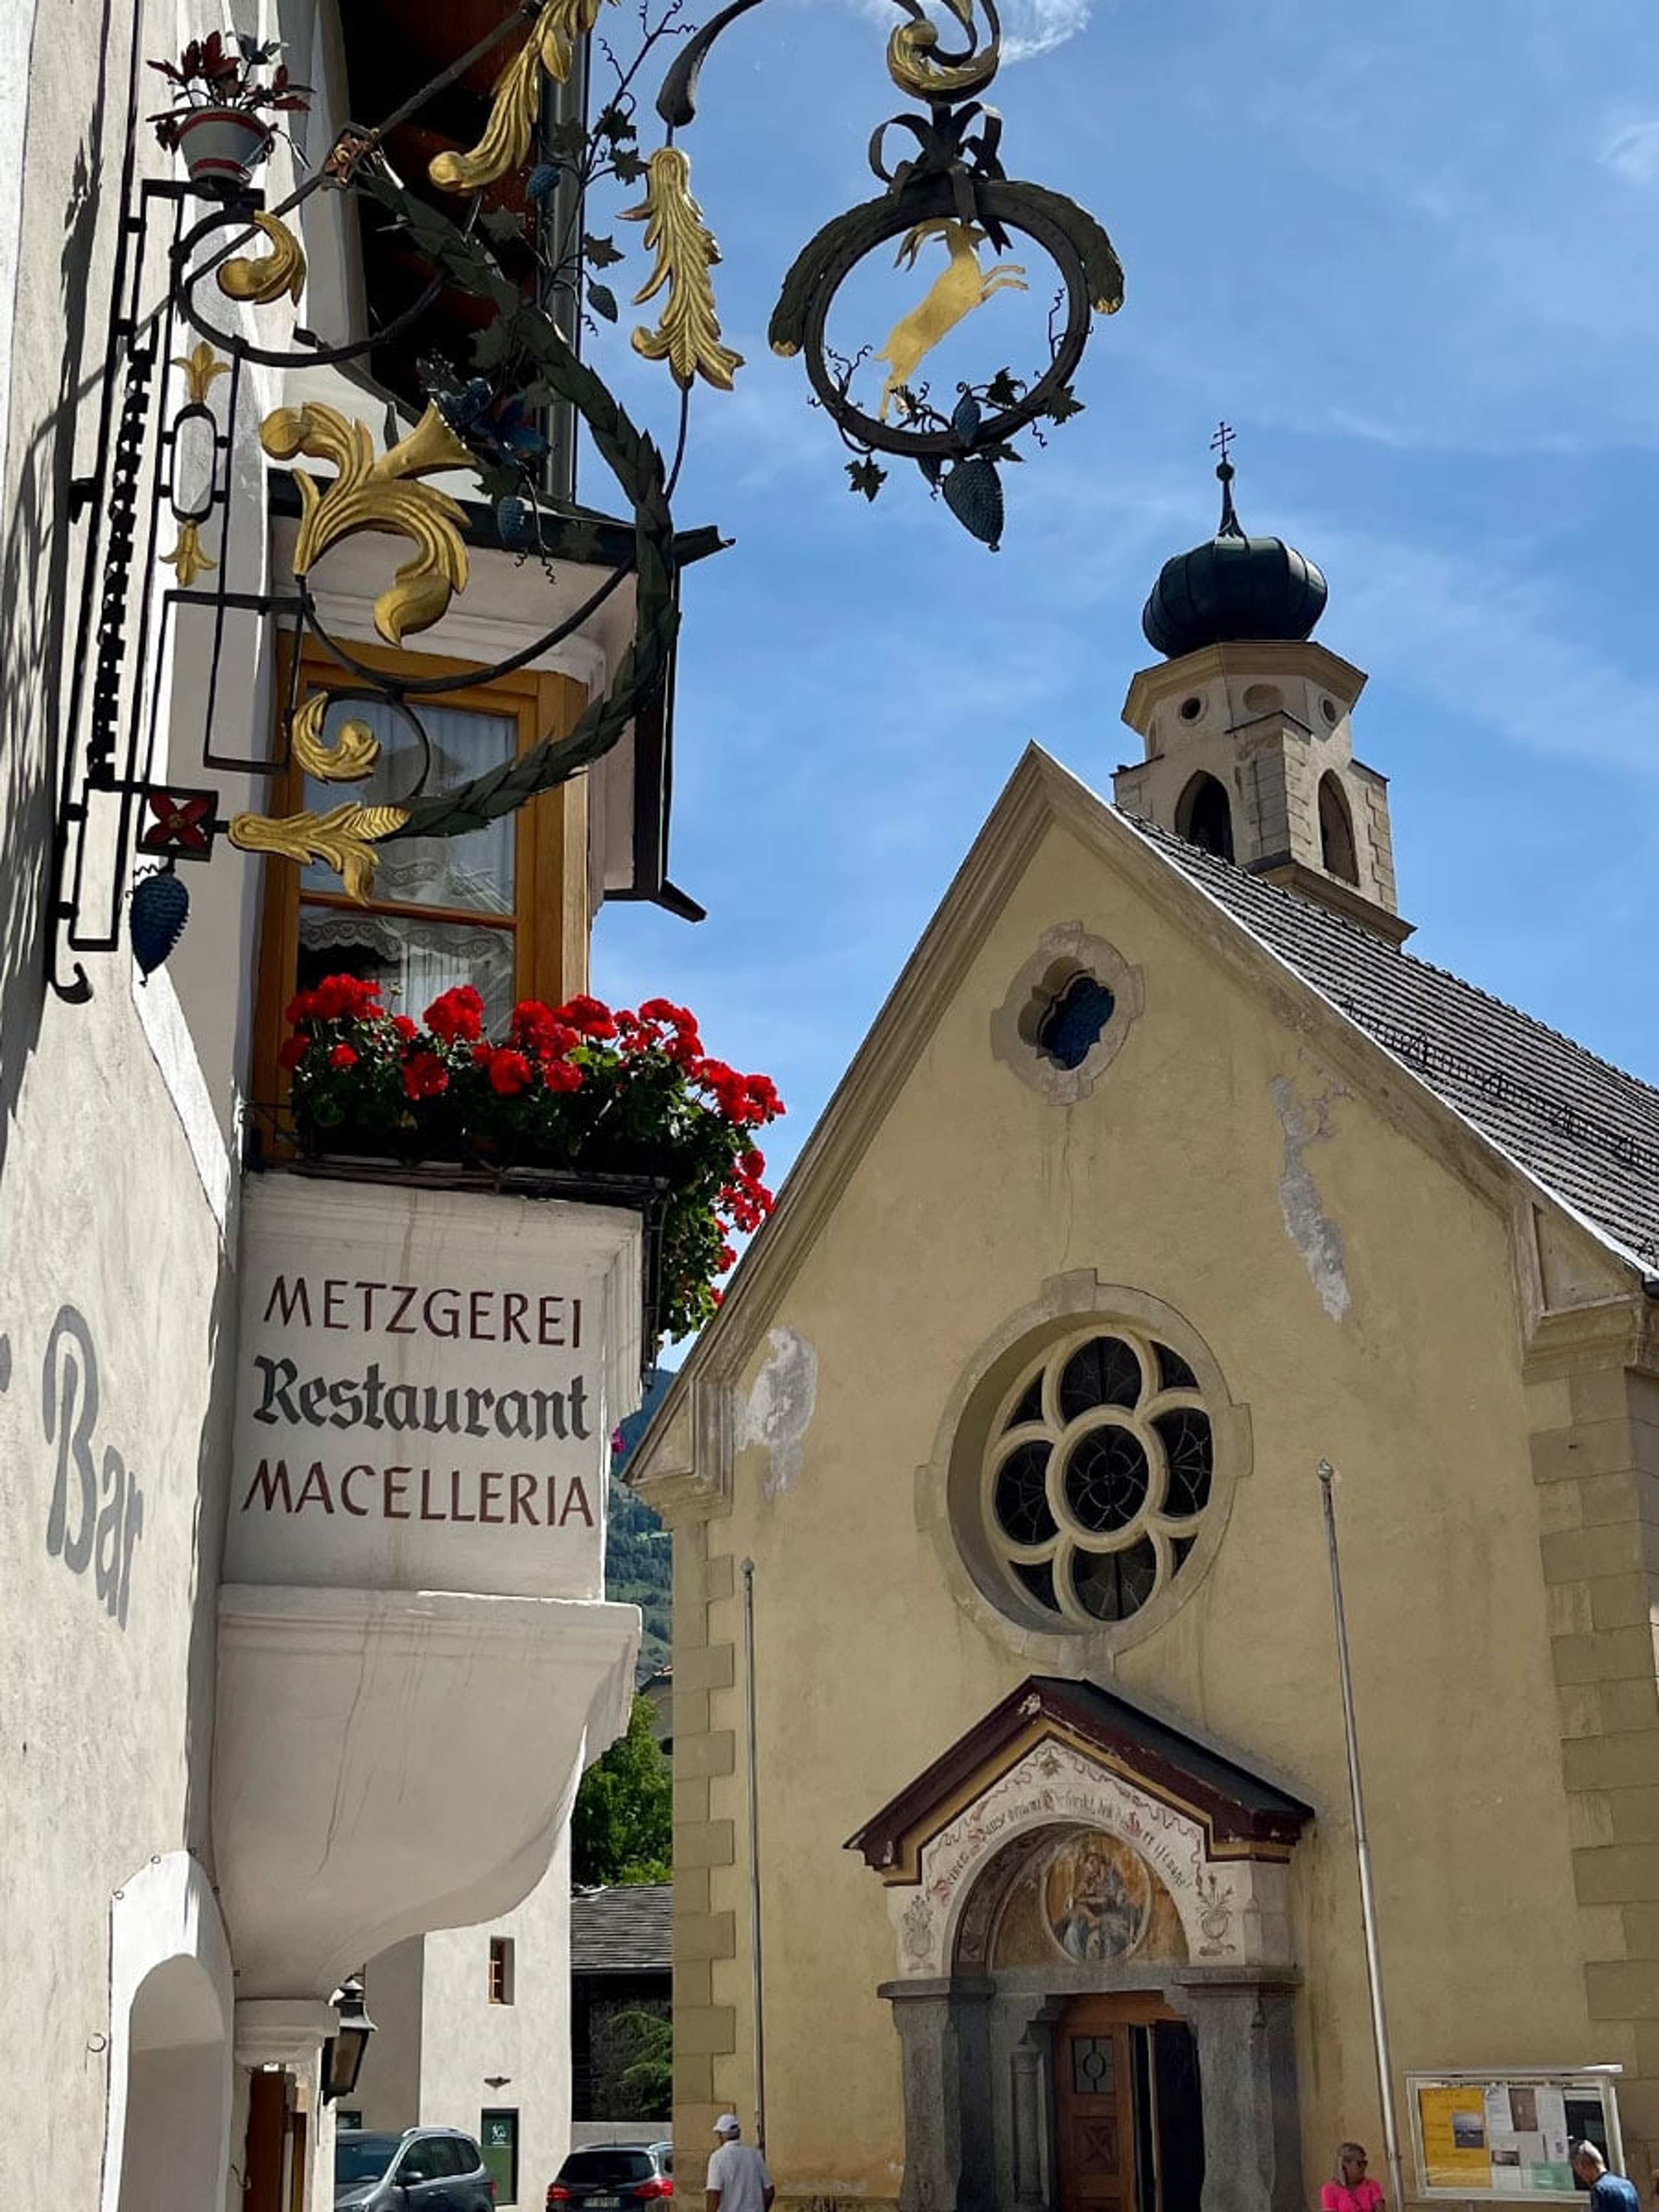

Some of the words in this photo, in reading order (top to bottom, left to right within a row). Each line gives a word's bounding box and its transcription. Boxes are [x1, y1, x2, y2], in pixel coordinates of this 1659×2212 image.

[264, 1275, 582, 1348] METZGEREI
[253, 1355, 591, 1440] Restaurant
[43, 1305, 143, 1632] Bar
[242, 1459, 594, 1527] MACELLERIA
